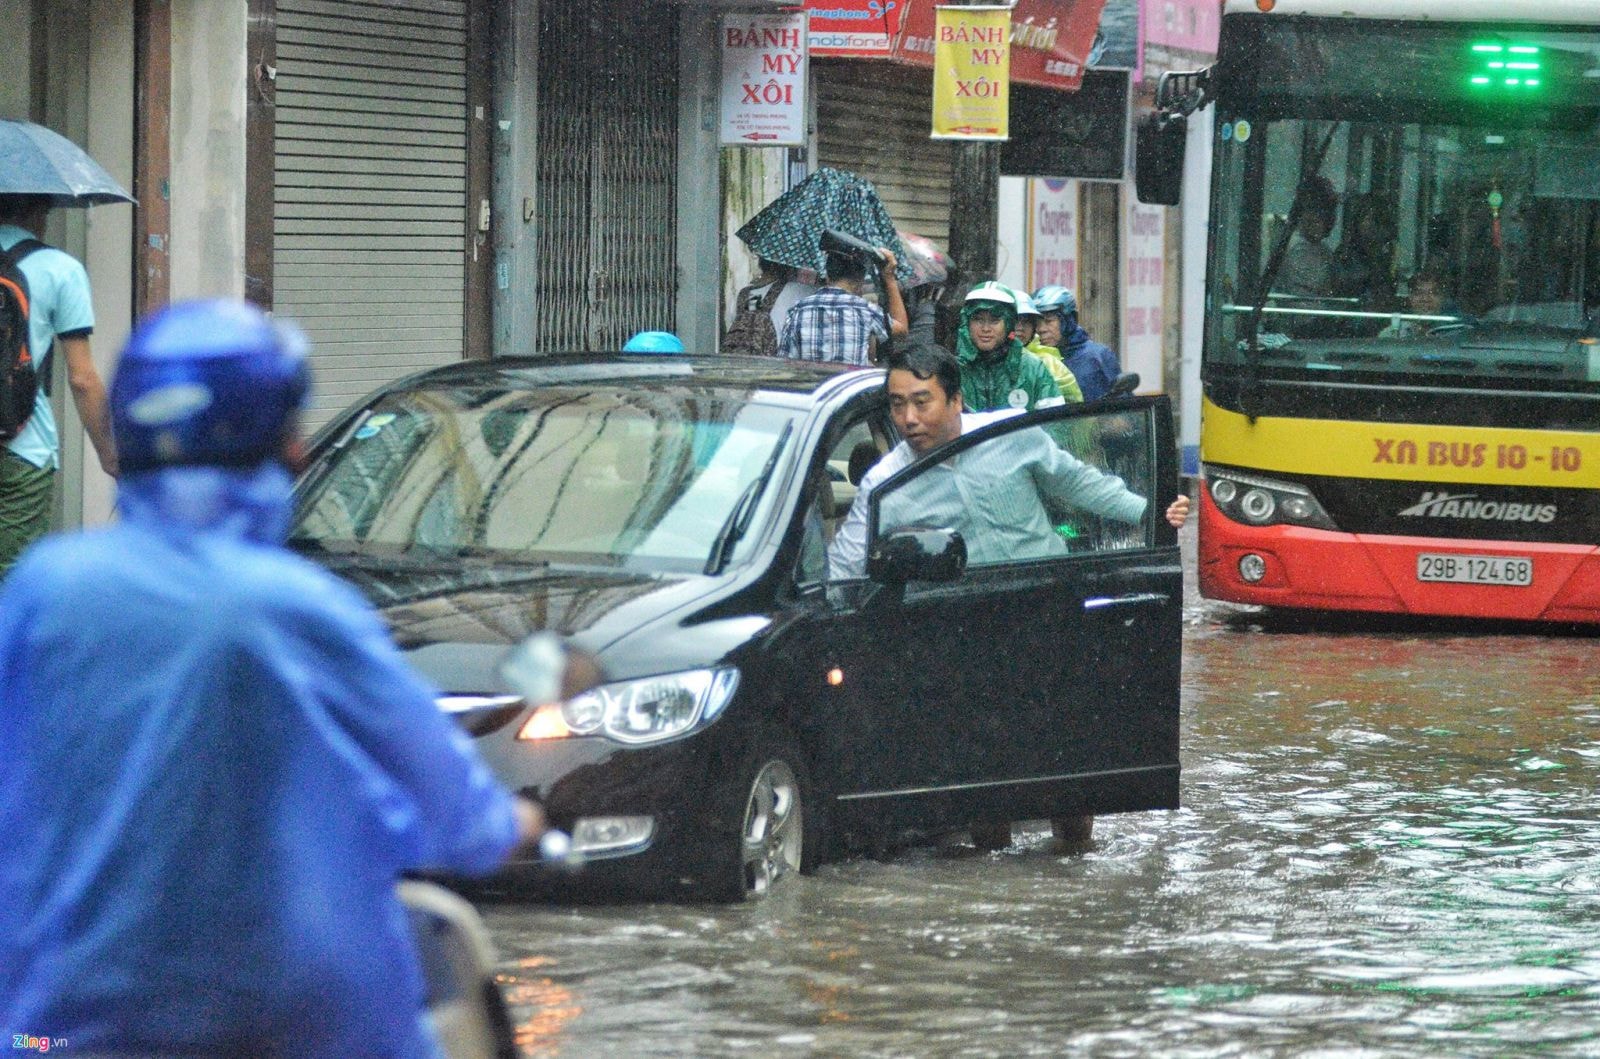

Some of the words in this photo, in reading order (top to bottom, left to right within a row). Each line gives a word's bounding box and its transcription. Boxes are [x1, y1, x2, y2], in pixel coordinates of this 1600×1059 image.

[726, 22, 800, 49] BÁNH
[941, 21, 1004, 43] BÁNH
[741, 78, 793, 105] XÔI
[956, 76, 999, 97] XÔI
[1428, 441, 1487, 468] BUS
[1398, 492, 1557, 523] HANOIBUS
[1421, 557, 1528, 582] 29B-124.68
